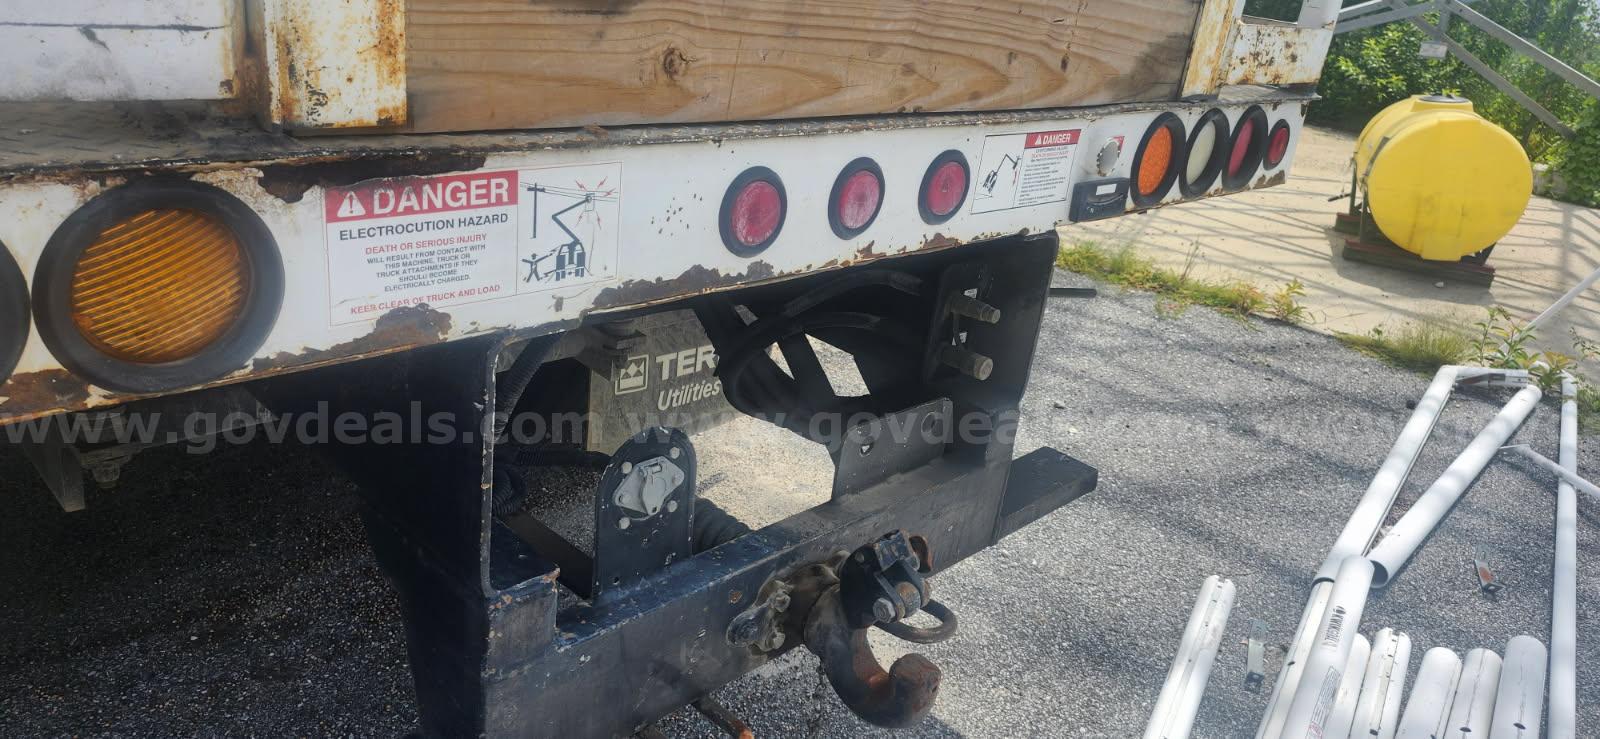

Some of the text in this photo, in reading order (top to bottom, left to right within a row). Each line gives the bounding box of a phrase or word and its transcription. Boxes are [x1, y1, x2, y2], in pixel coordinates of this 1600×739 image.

[1043, 133, 1071, 144] DANGER
[373, 178, 509, 214] DANGER
[339, 213, 509, 241] ELECTROCUTION HAZARD
[365, 233, 487, 255] DEATH OR SERIOUS INJURY
[386, 253, 414, 261] RESULT
[415, 250, 436, 258] FROM
[436, 246, 468, 255] CONTACT
[436, 255, 459, 263] TRUCK
[399, 269, 457, 283] SHOULD BECOME
[402, 263, 452, 275] ATTACHMENTS
[384, 280, 435, 292] ELECTRICALLY
[351, 284, 501, 314] KEEP CLEAR OF TRUCK AND LOAD
[655, 345, 719, 381] TER
[657, 380, 722, 411] Utilities
